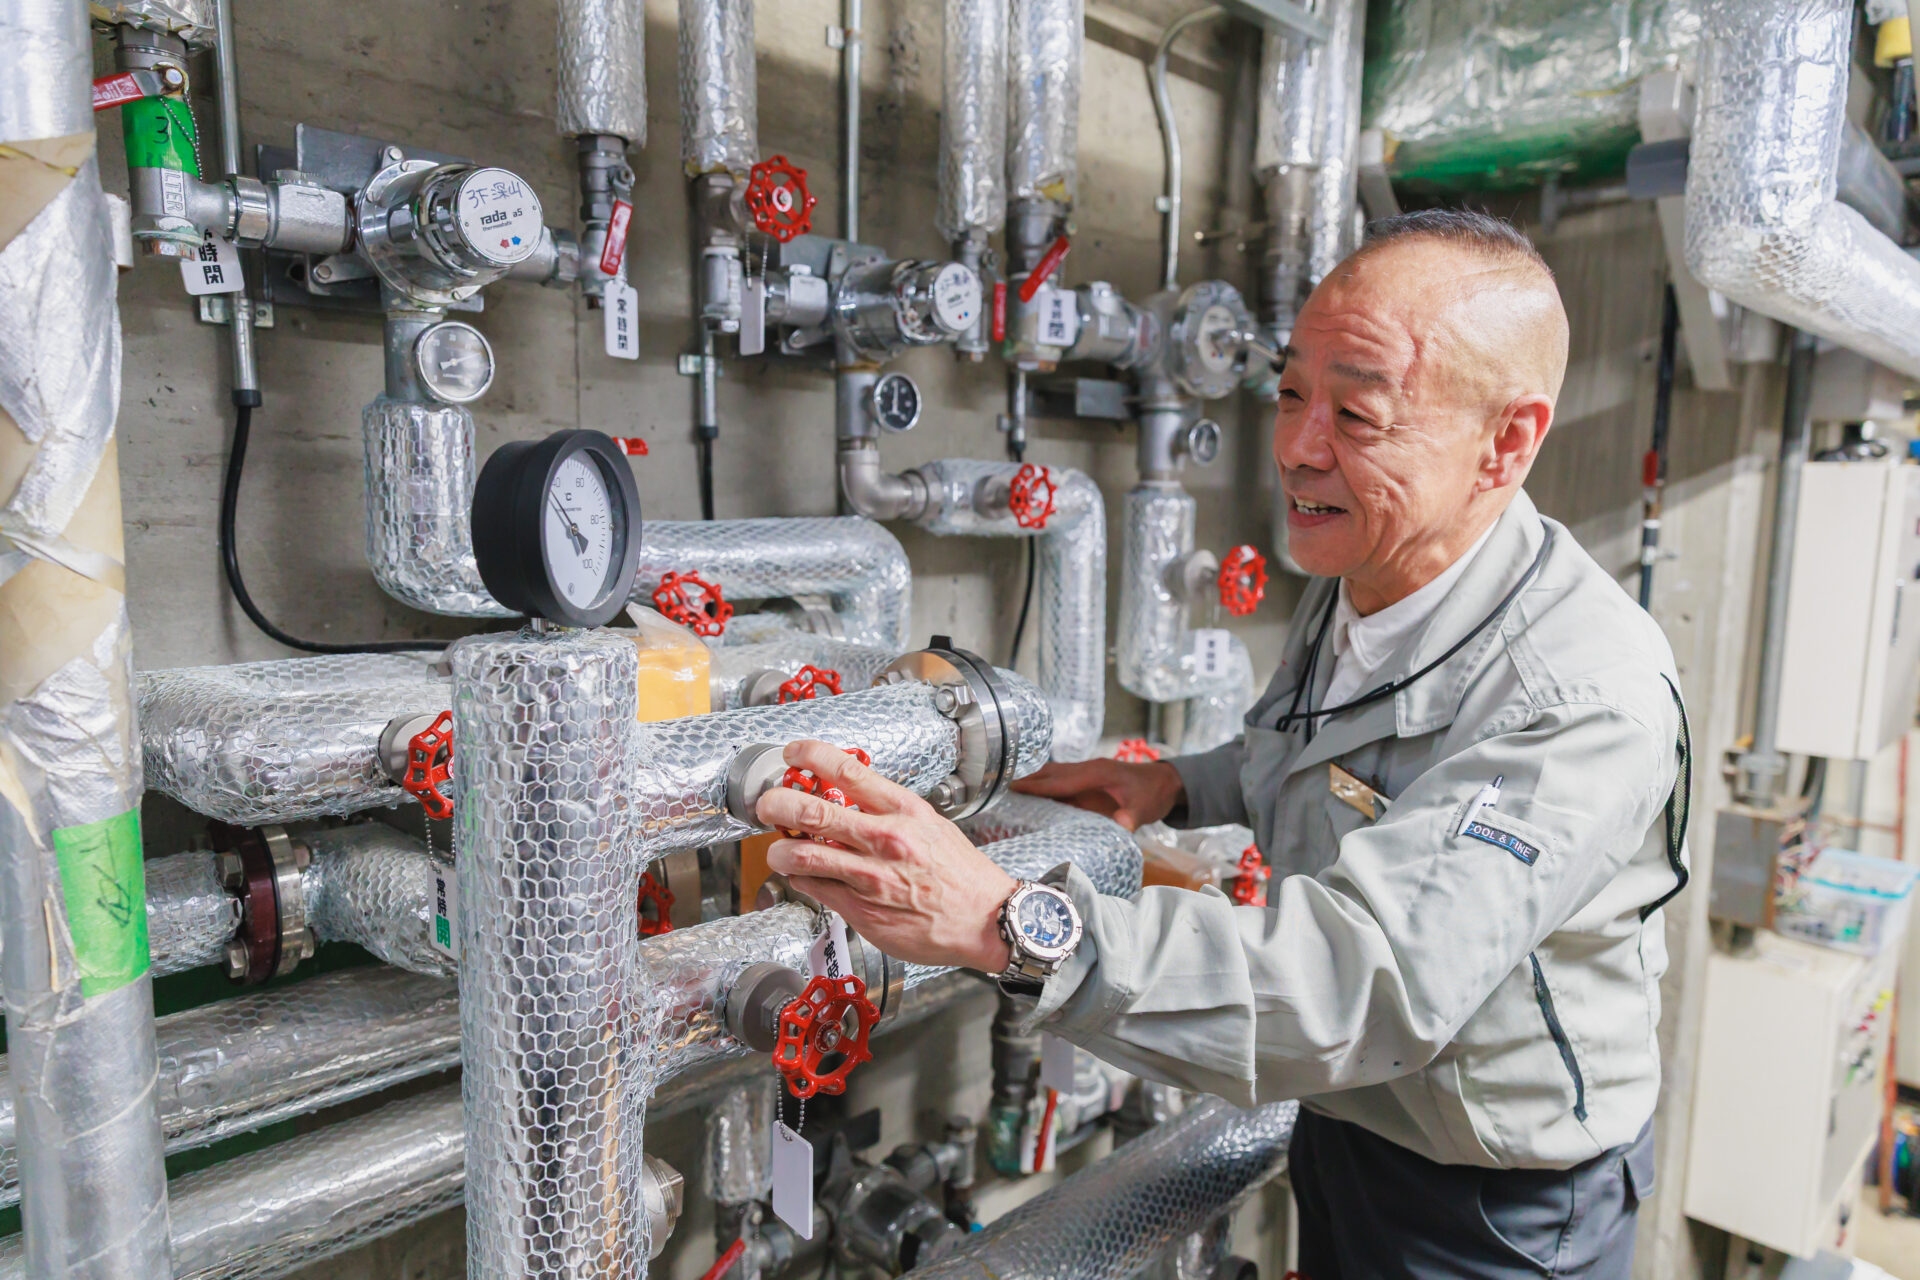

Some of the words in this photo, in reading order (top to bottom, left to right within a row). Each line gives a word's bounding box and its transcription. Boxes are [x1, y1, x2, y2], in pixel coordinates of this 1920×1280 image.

[152, 116, 170, 144] 3
[480, 210, 508, 226] rada
[512, 208, 523, 218] a5
[575, 477, 585, 488] 60
[591, 514, 600, 525] 80
[583, 559, 593, 569] 100
[1499, 834, 1507, 843] &
[1509, 837, 1532, 858] FINE
[824, 940, 844, 979] 常時
